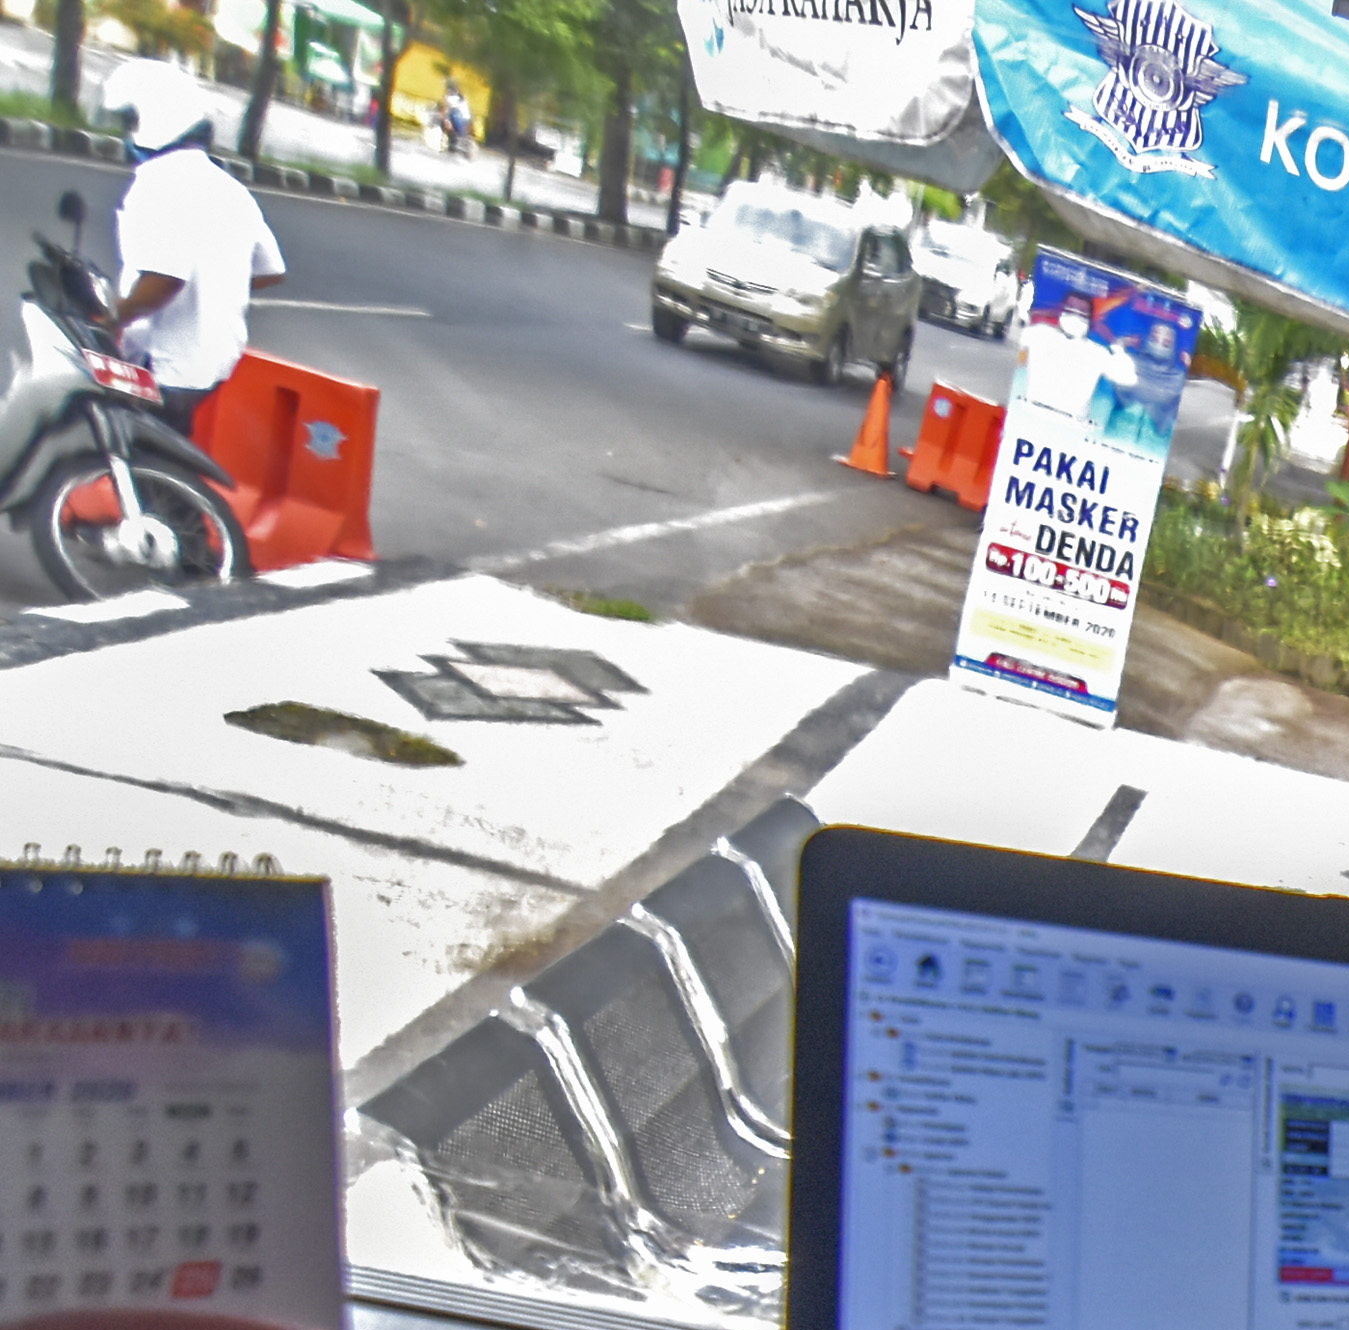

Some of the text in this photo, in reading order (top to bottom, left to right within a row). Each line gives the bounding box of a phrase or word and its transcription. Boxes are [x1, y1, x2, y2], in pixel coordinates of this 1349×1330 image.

[1013, 438, 1110, 495] PAKAI
[1005, 475, 1140, 543] MASKER
[1035, 524, 1135, 581] DENDA
